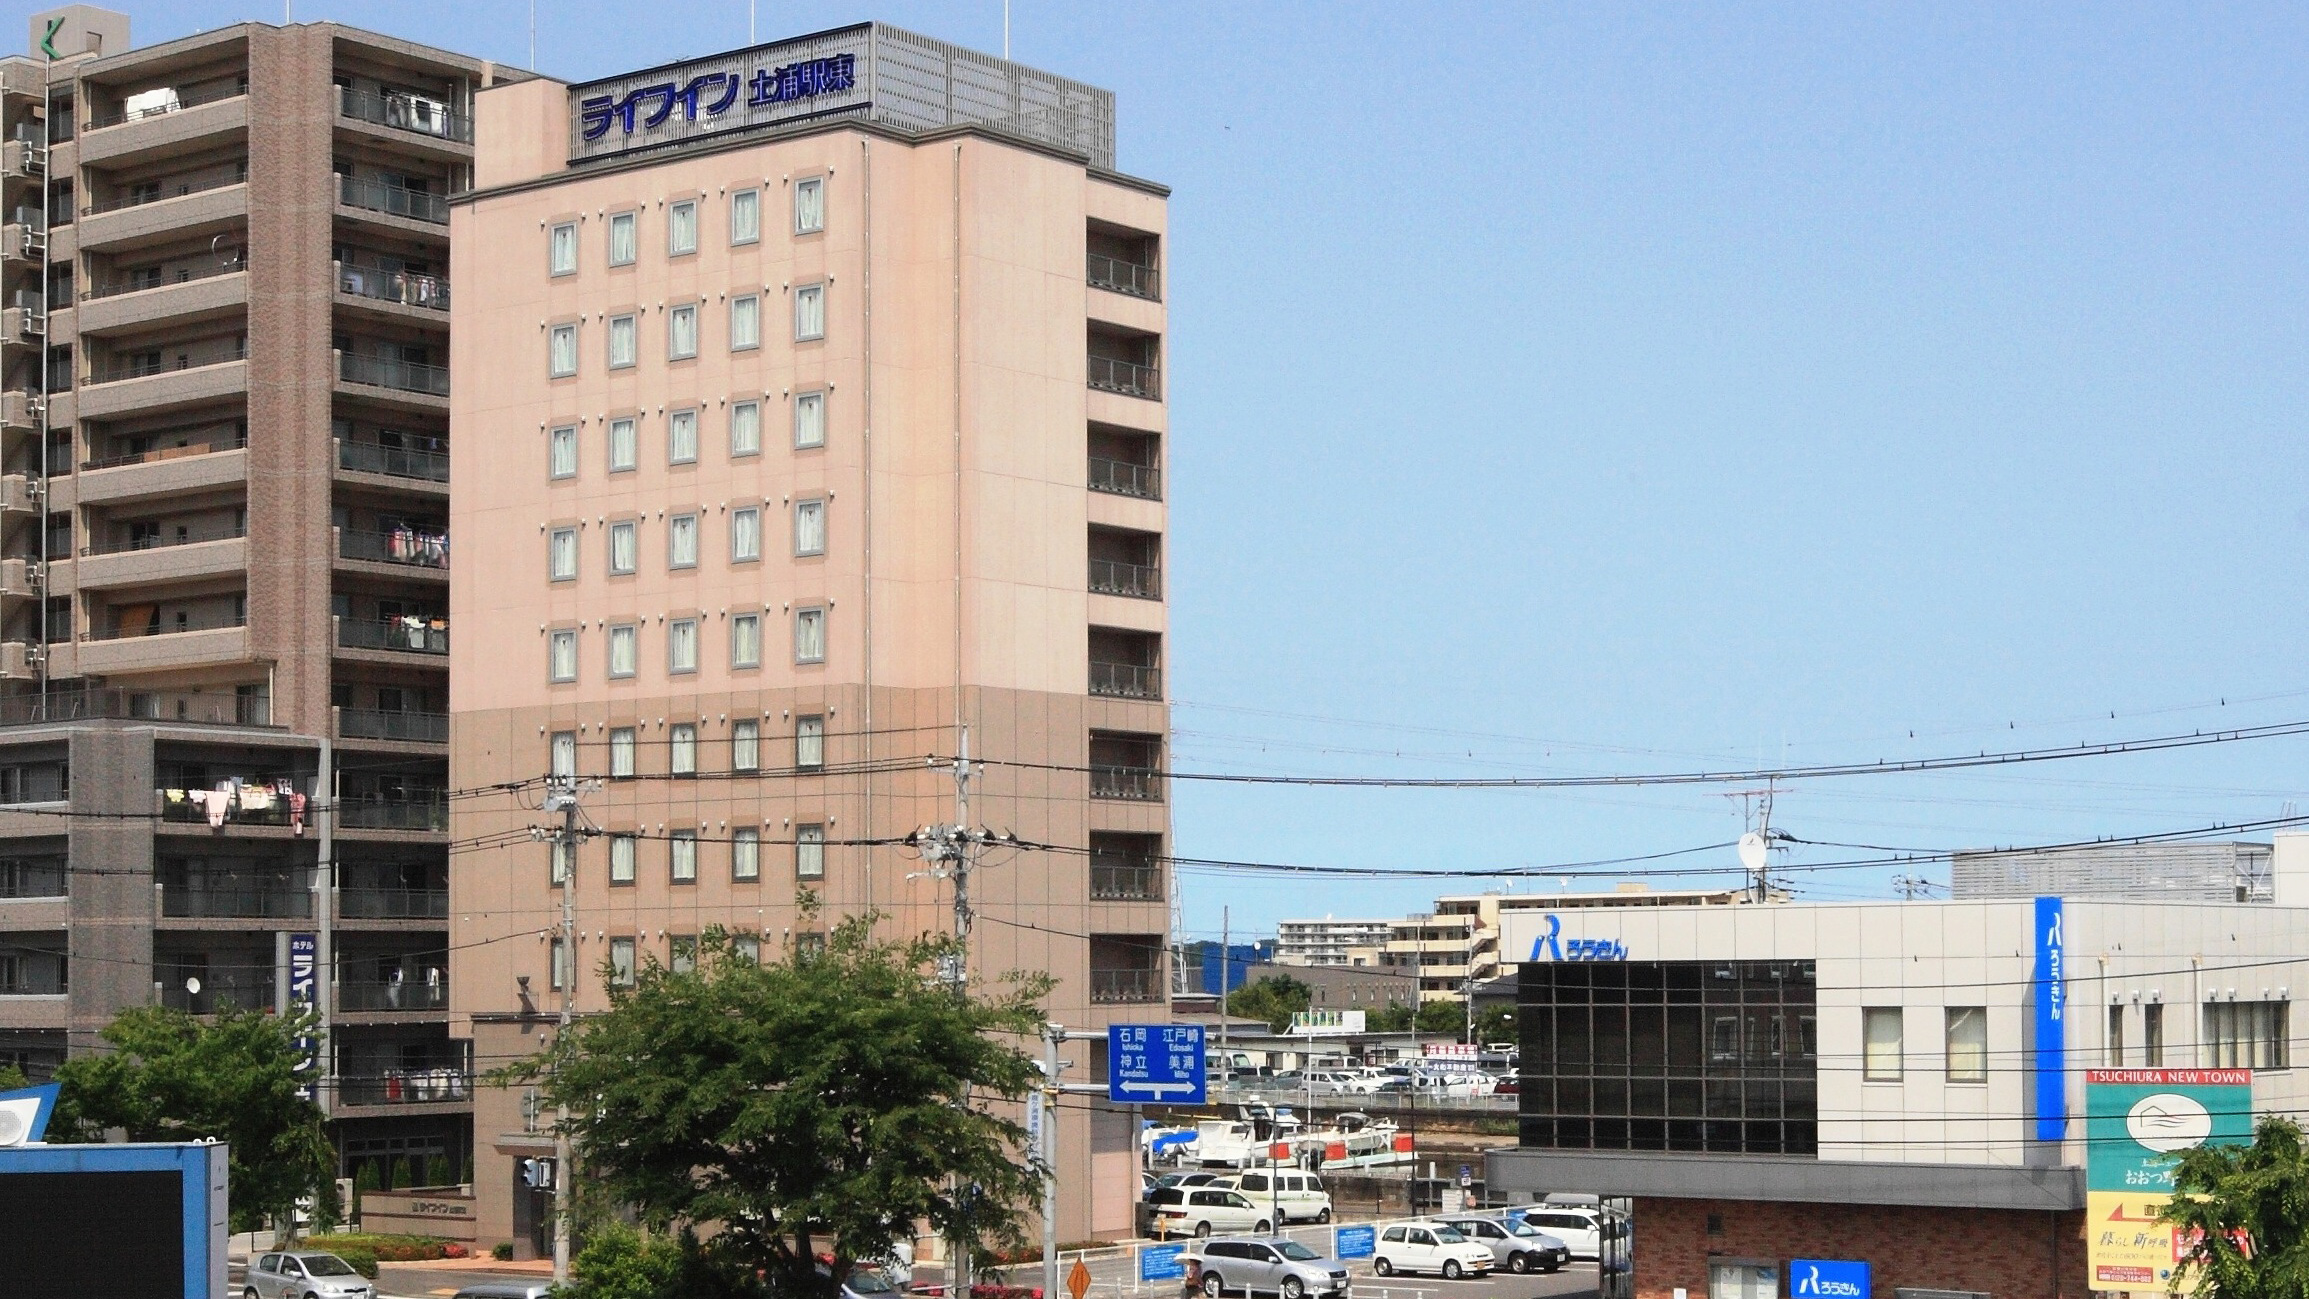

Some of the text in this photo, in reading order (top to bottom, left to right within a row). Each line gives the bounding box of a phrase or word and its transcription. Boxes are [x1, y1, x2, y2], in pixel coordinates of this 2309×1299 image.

[581, 53, 855, 141] ライフイン 土浦駅東
[292, 940, 314, 950] ホテル
[1566, 938, 1629, 962] ろうきん
[2050, 948, 2062, 1020] ろうきん
[1119, 1028, 1147, 1043] 石岡
[1162, 1028, 1199, 1043] 江戸崎
[1120, 1054, 1148, 1069] 神立
[1168, 1055, 1195, 1070] 美浦
[2092, 1071, 2246, 1083] TSUCHIURA NEW TOWN
[1821, 1281, 1860, 1296] ろうきん
